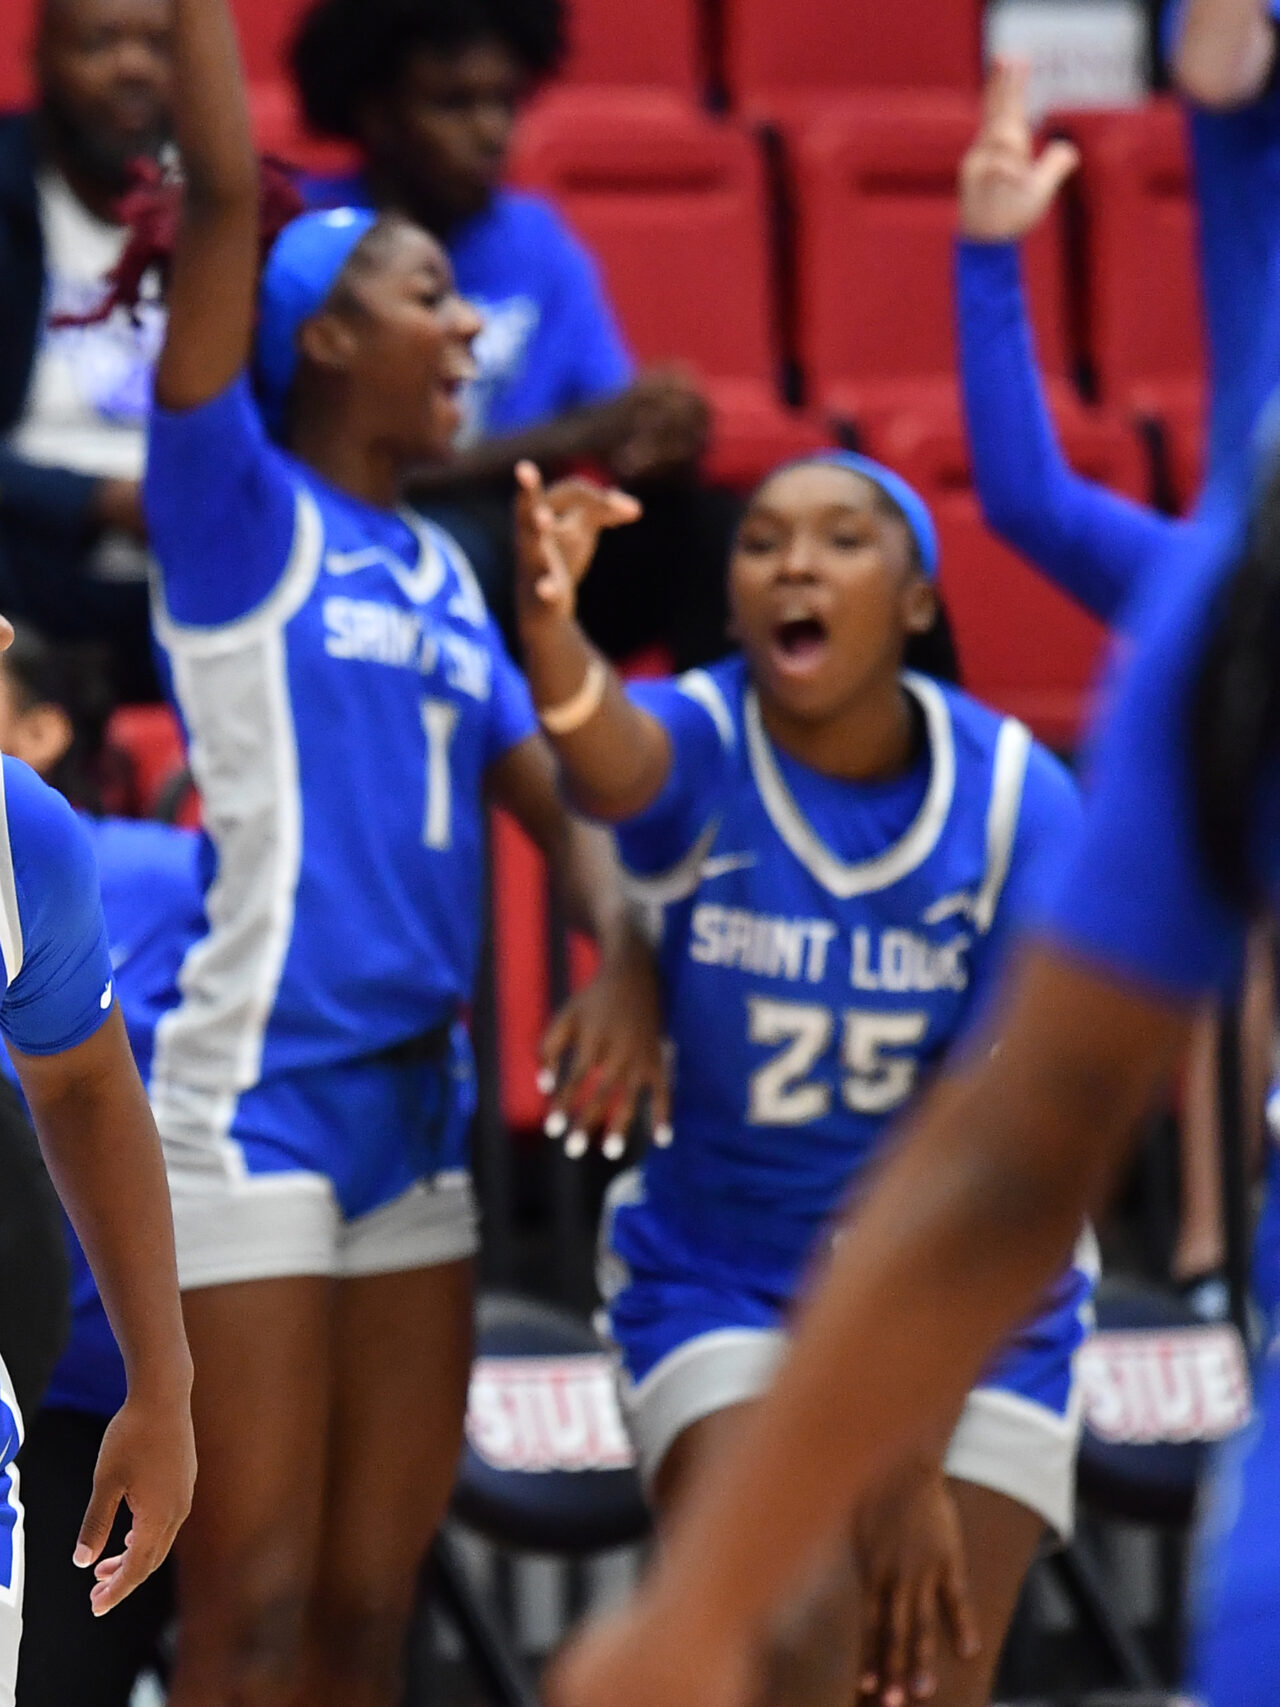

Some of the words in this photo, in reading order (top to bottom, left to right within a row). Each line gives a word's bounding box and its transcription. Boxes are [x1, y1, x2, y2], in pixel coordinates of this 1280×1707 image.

[422, 697, 458, 852] 1
[689, 902, 837, 983] SAINT
[748, 995, 927, 1126] 25
